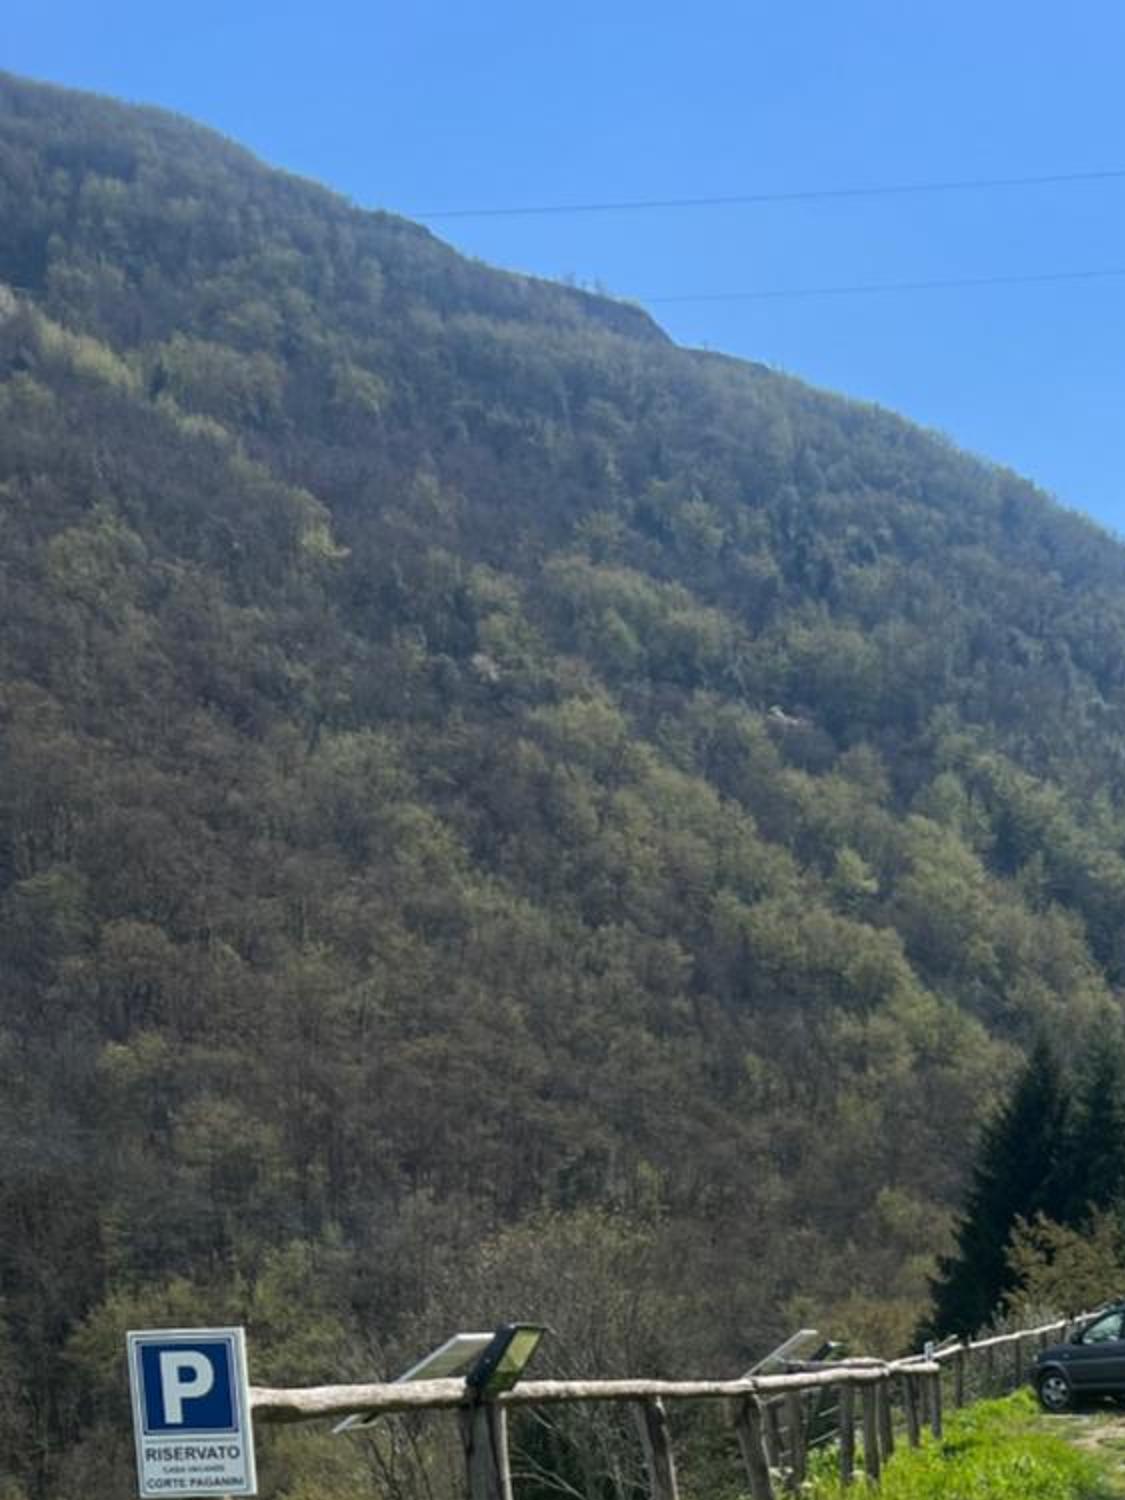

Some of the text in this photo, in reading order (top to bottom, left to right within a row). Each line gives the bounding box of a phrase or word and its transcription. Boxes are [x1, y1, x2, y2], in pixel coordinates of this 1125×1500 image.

[159, 1350, 215, 1424] P
[145, 1446, 241, 1461] RISERVATO
[146, 1477, 187, 1489] CORTE
